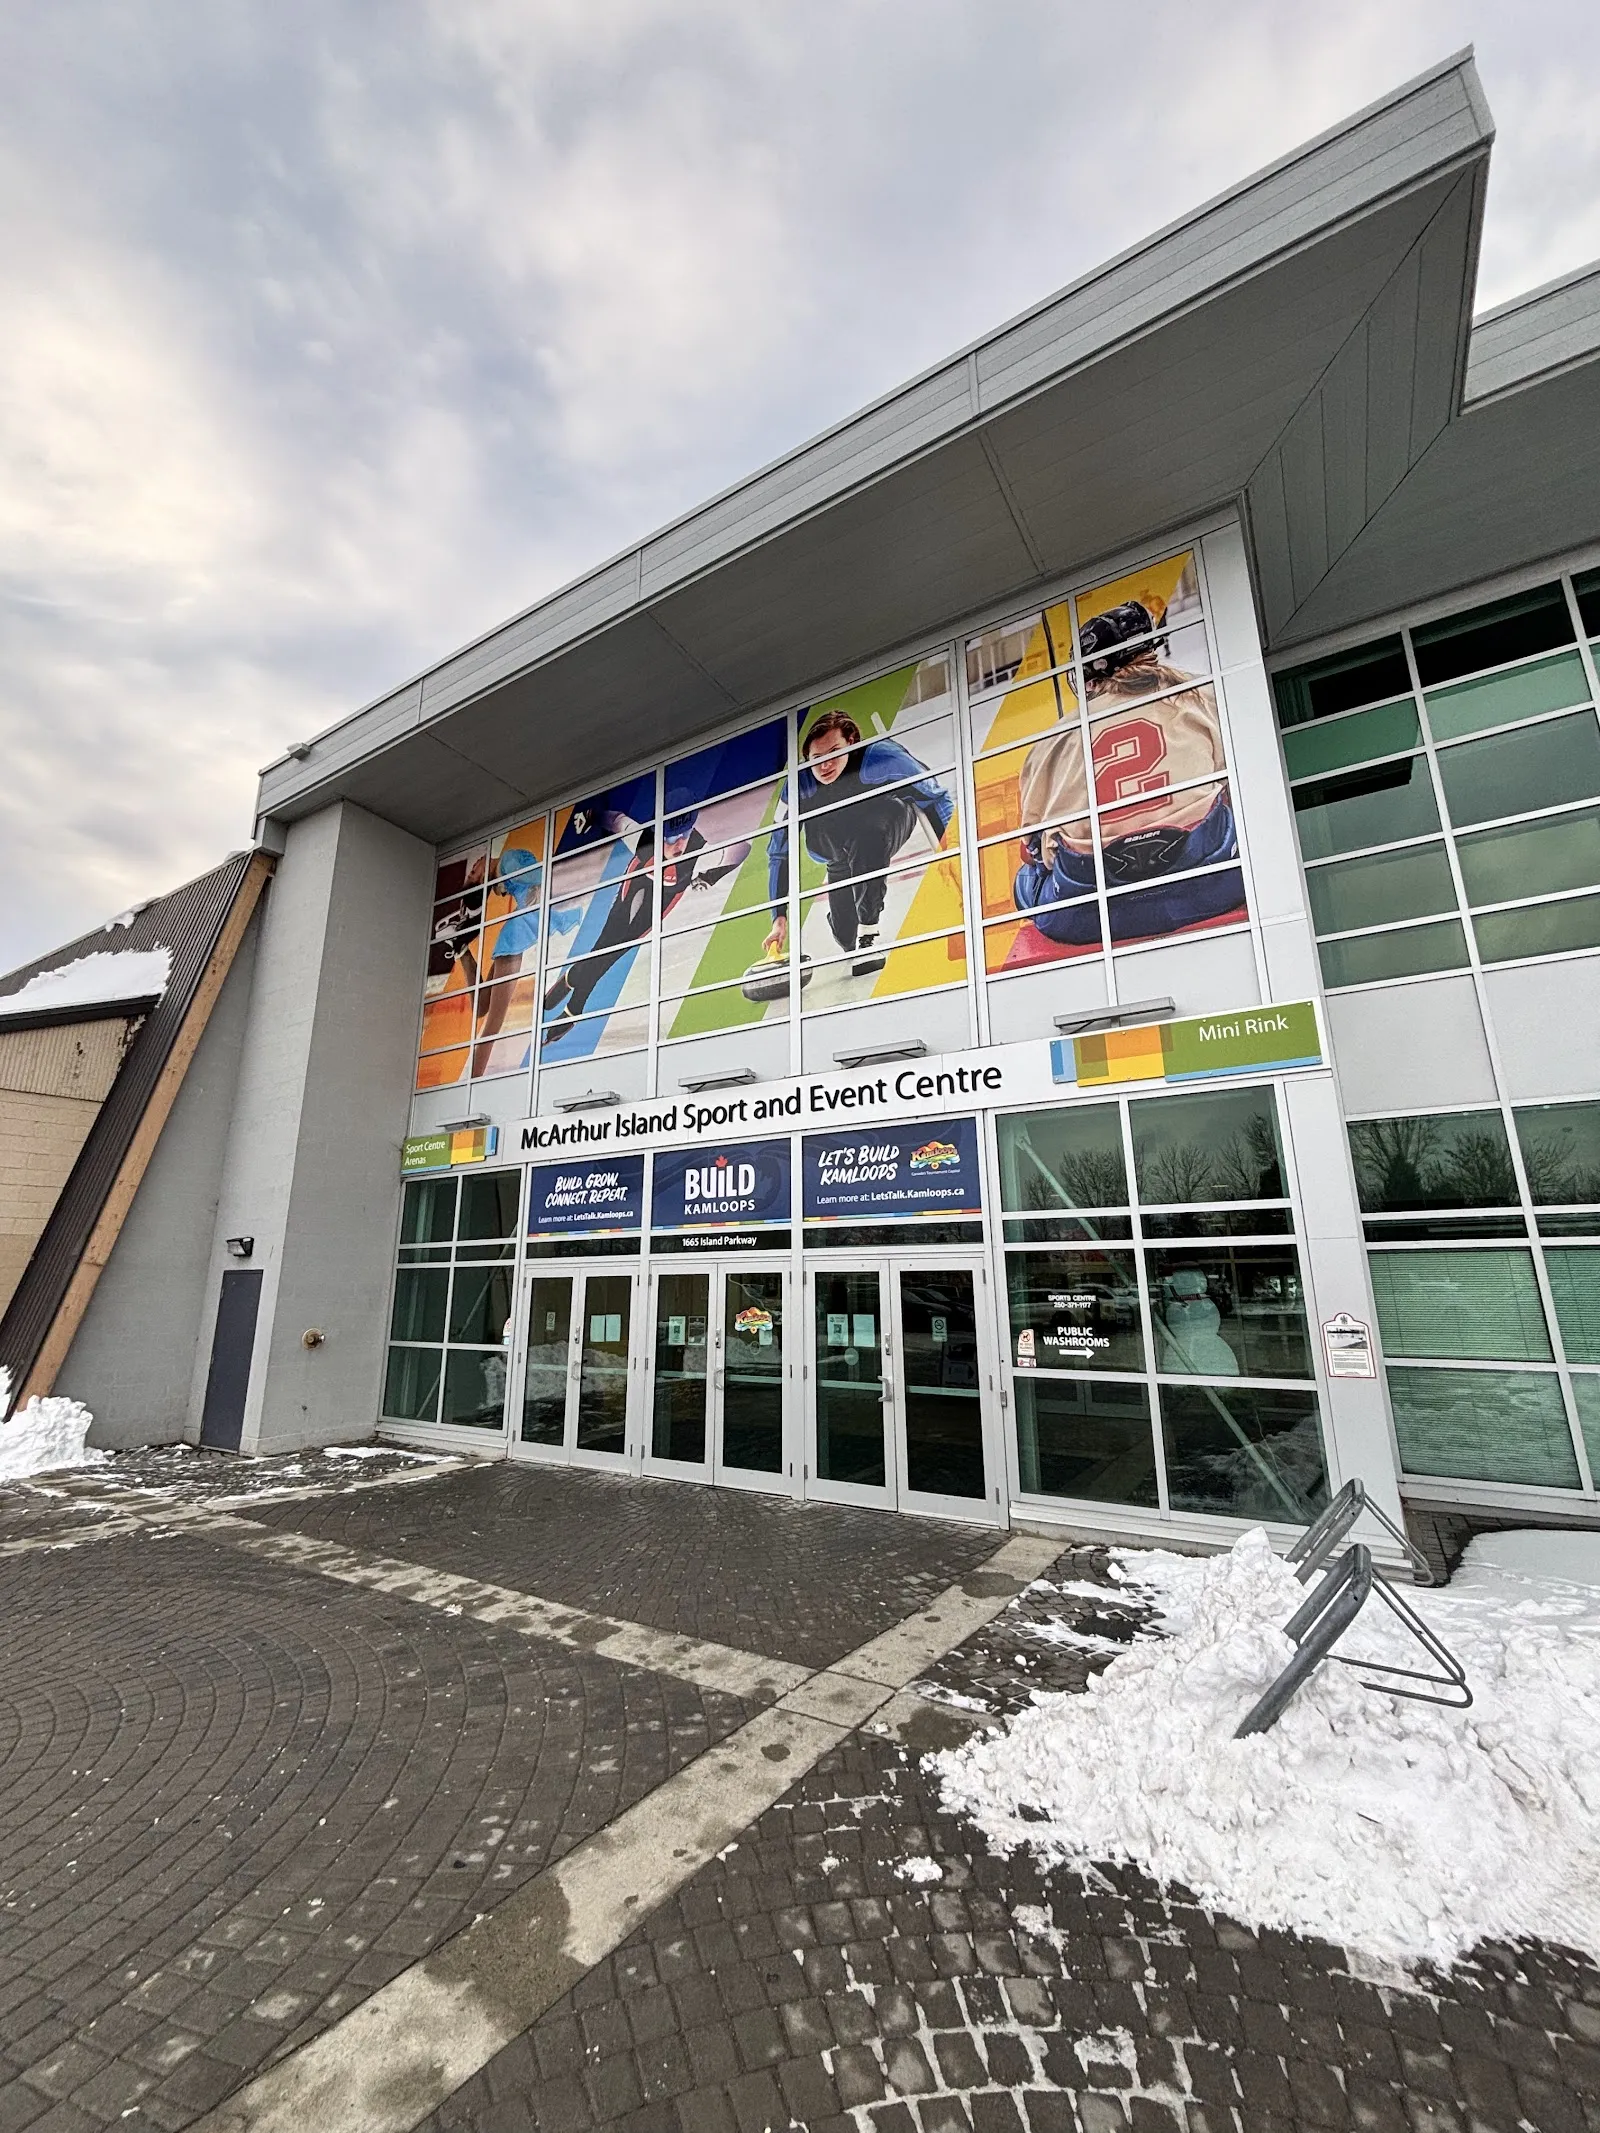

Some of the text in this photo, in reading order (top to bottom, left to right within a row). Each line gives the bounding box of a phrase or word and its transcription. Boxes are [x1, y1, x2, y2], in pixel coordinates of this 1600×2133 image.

[1091, 717, 1173, 825] 2
[1199, 1014, 1289, 1042] Mini Rink
[520, 1066, 1003, 1150] McArthur Island Sport and Event Centre
[406, 1140, 446, 1154] Sport Centre
[911, 1146, 958, 1162] Kamloops
[404, 1156, 426, 1166] Arenas
[818, 1144, 900, 1167] LET'S BUILD
[555, 1172, 619, 1192] BUILD. GROW.
[820, 1163, 899, 1186] KAMLOOPS
[545, 1186, 628, 1209] CONNECT. REPEAT.
[816, 1196, 837, 1205] Learn
[859, 1194, 870, 1202] at:
[871, 1187, 965, 1202] LetsTalk.Kamloops.ca
[684, 1199, 756, 1215] KAMLOOPS
[574, 1210, 634, 1221] LetsTalk.Kamloops.ca
[682, 1235, 757, 1247] 1665 Island Parkway
[1072, 1294, 1097, 1302] CENTRE
[1057, 1326, 1094, 1337] PUBLIC
[1043, 1336, 1110, 1348] WASHROOMS
